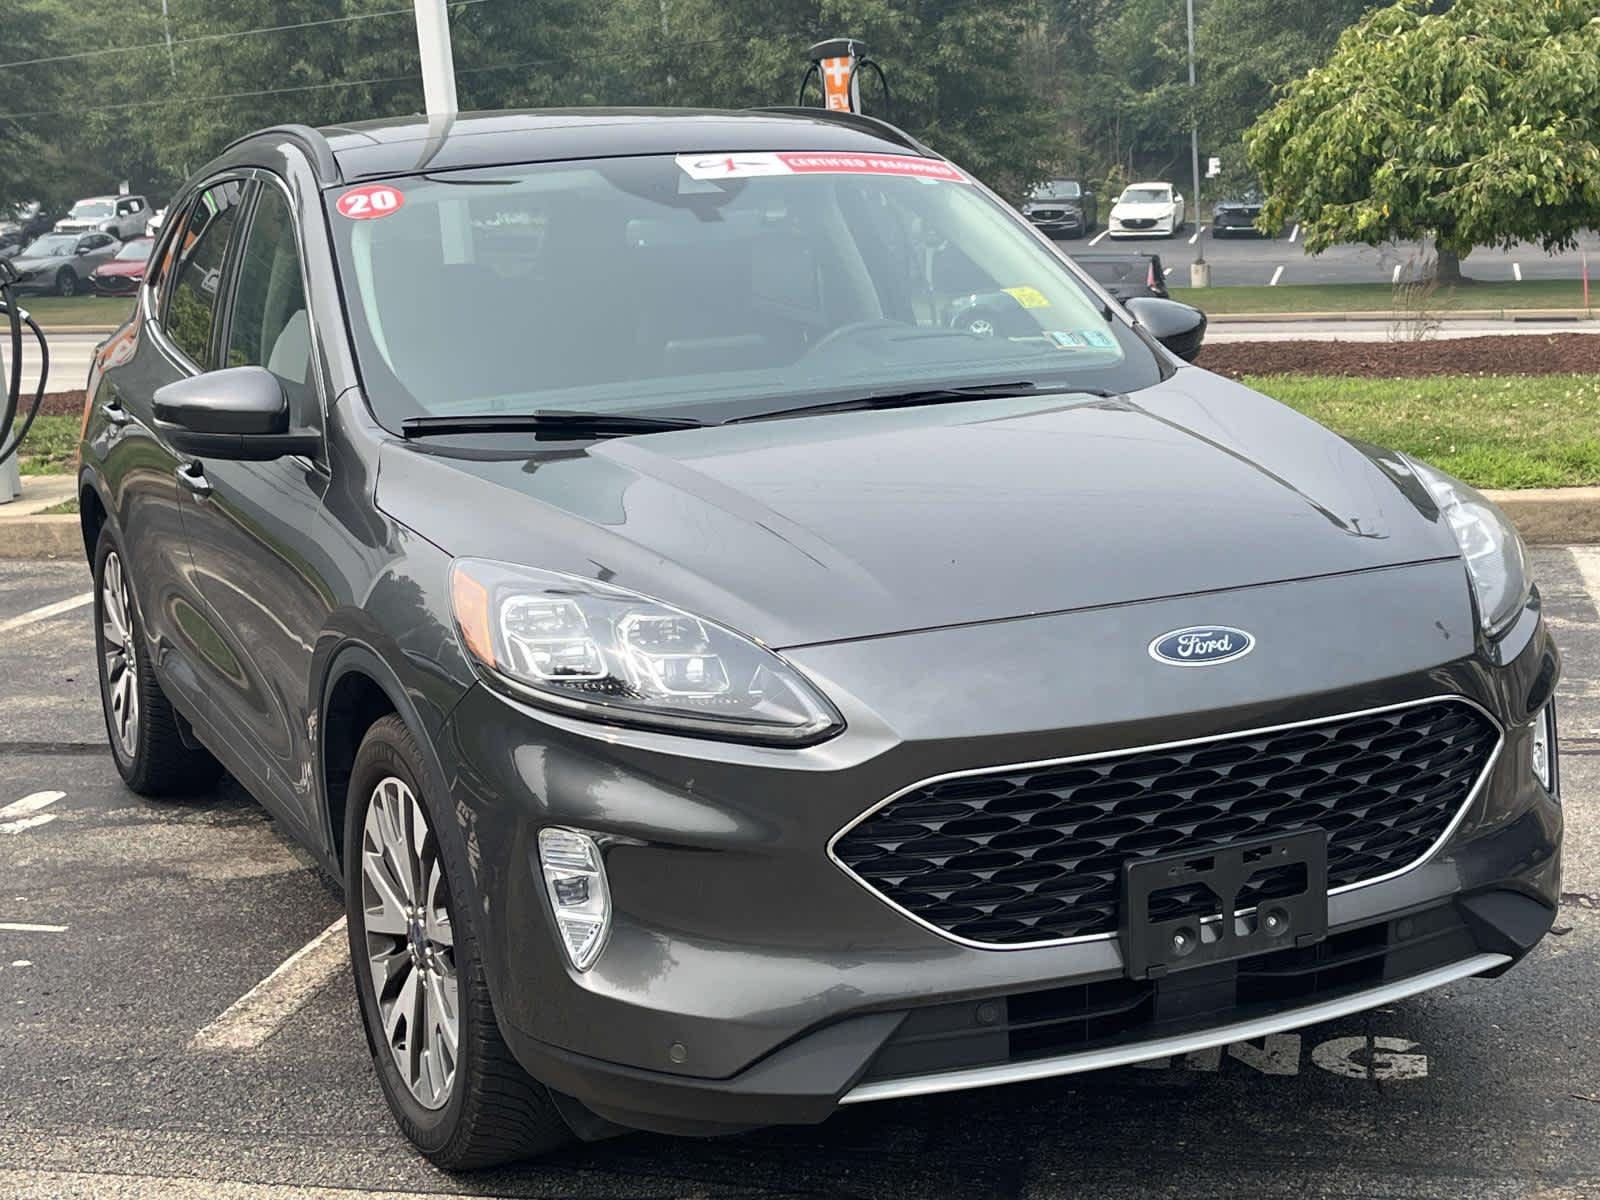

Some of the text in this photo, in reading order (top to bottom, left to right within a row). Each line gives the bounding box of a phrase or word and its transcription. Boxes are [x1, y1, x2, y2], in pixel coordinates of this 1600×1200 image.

[787, 157, 867, 168] CERTIFIED
[344, 191, 397, 215] 20
[1177, 631, 1233, 657] Ford
[1131, 1033, 1428, 1081] NG
